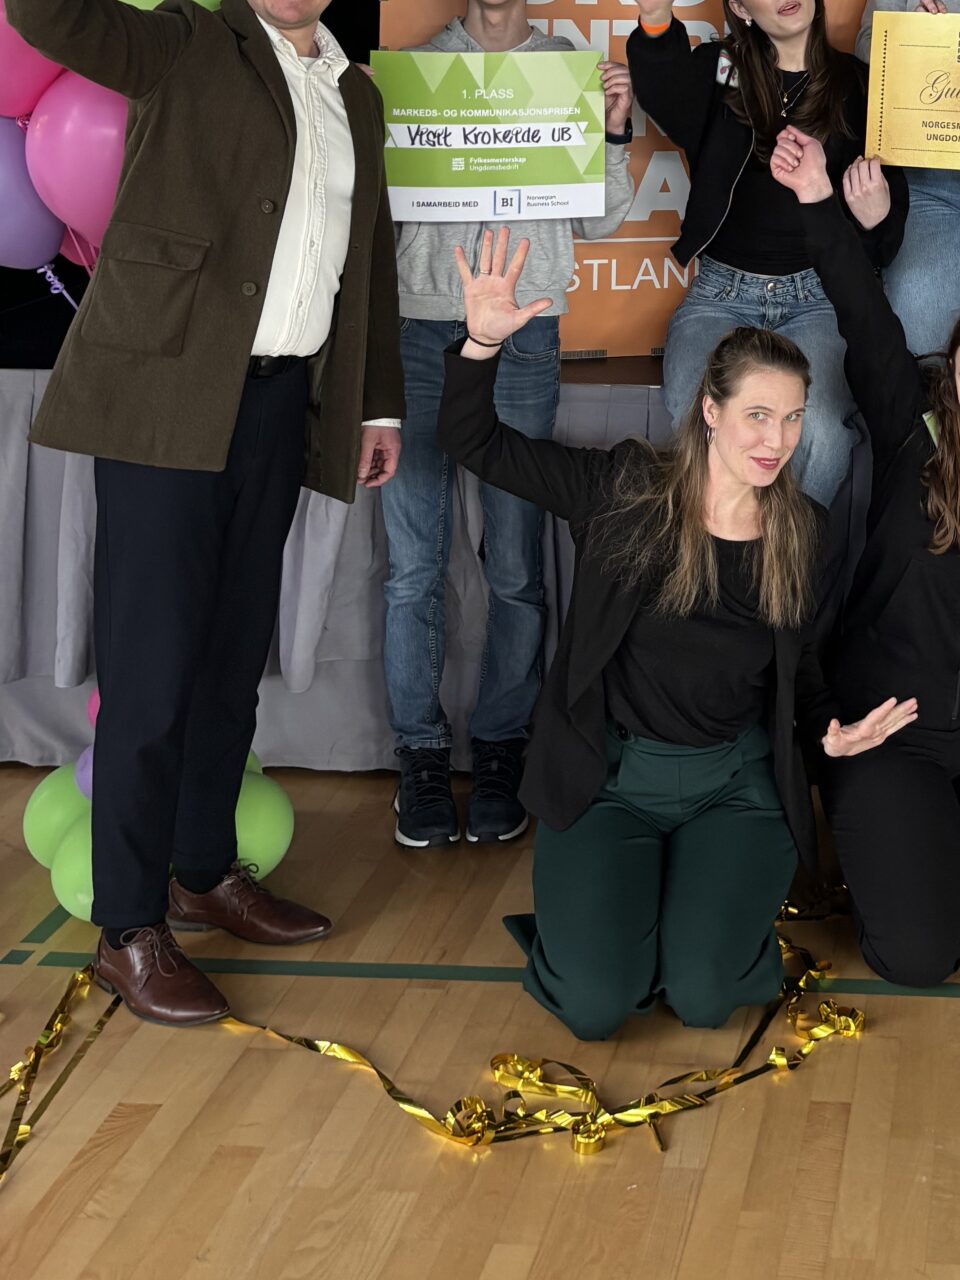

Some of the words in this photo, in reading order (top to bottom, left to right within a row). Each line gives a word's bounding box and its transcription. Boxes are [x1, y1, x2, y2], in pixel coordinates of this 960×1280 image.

[462, 90, 471, 99] 1.
[475, 89, 514, 99] PLASS
[393, 108, 441, 116] MARKEDS-
[444, 109, 457, 117] OG
[460, 107, 580, 117] KOMMUNIKASJONSPRISEN
[408, 125, 453, 147] Visit
[463, 127, 541, 145] Krokeide
[552, 127, 572, 142] UB
[501, 198, 513, 207] BI
